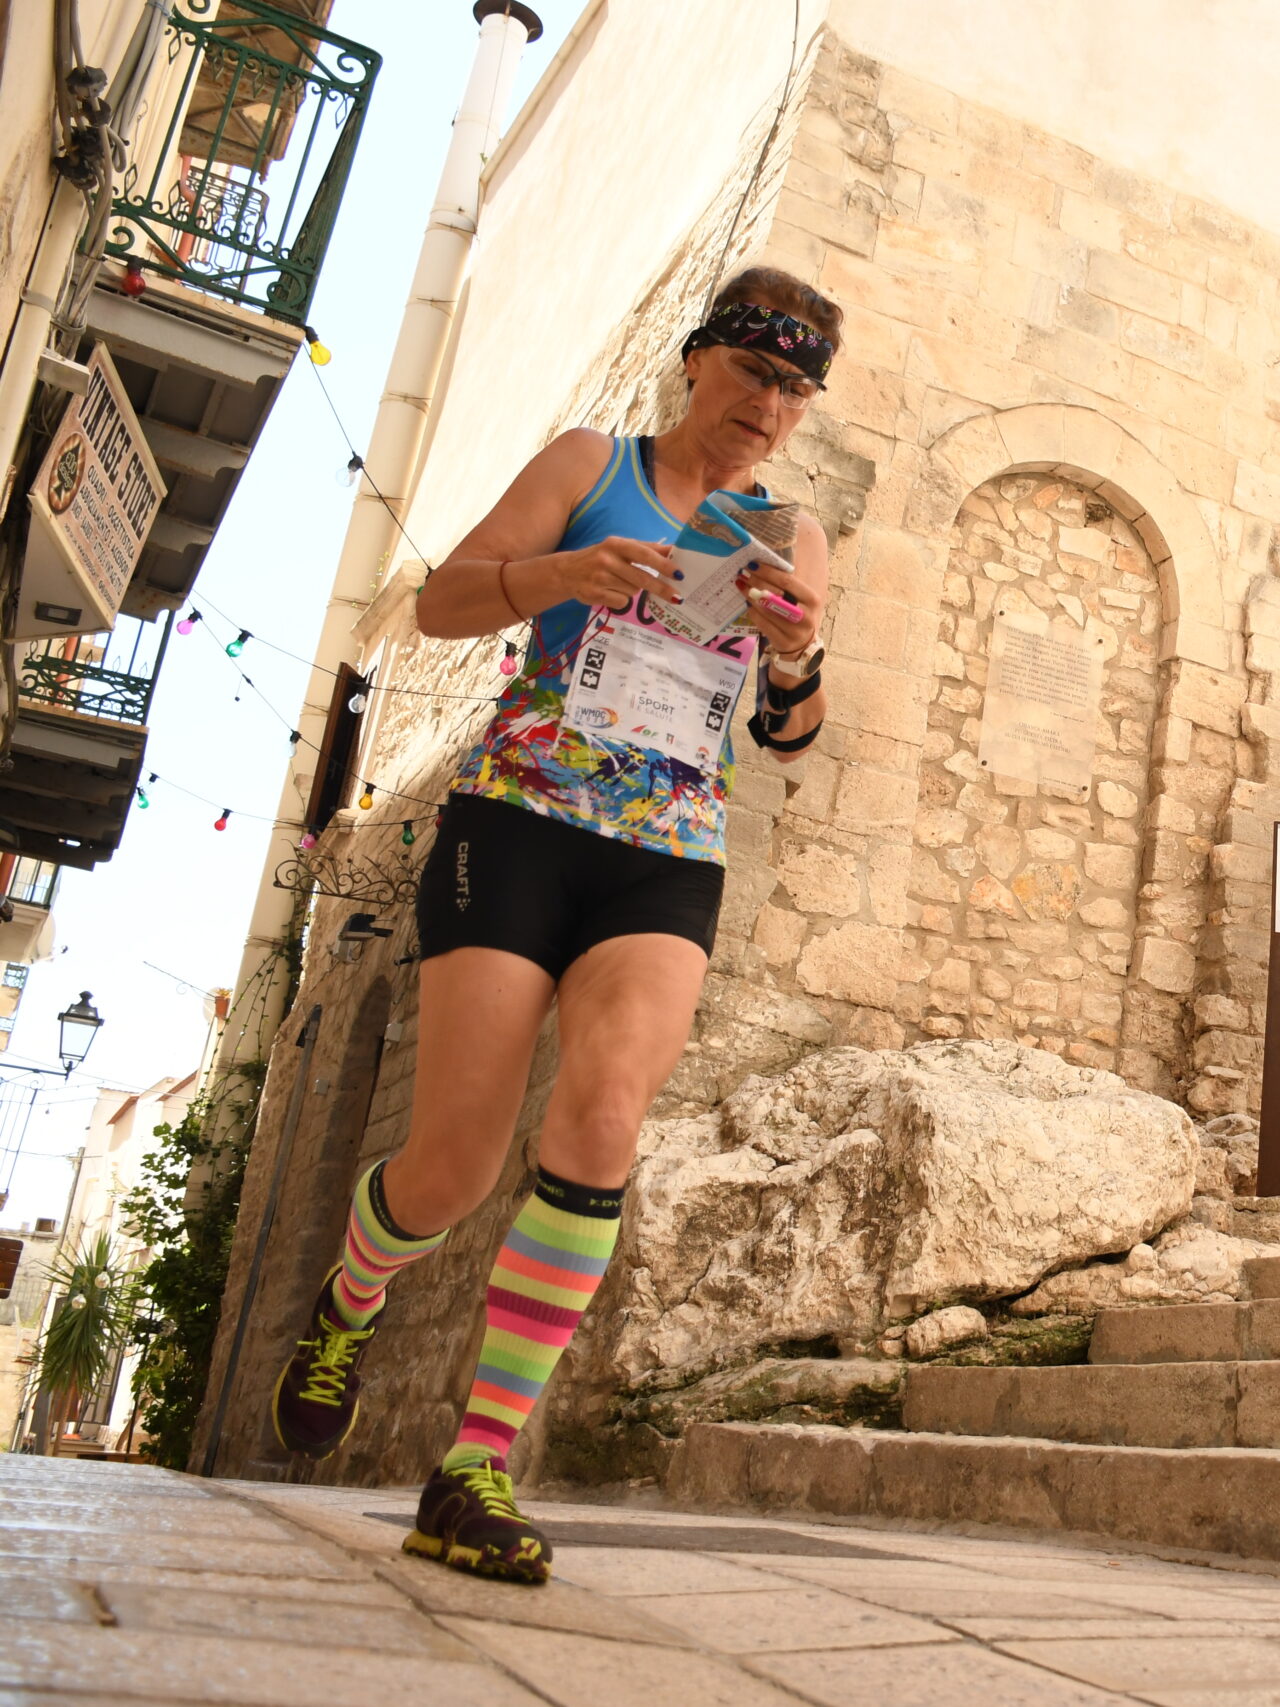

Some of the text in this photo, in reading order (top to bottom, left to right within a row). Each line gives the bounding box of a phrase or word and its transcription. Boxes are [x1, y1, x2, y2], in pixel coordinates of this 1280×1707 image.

[78, 366, 131, 485] VINTAGE
[117, 452, 156, 541] STORE
[88, 465, 107, 504] QUADRI
[639, 696, 675, 714] SPORT
[457, 841, 469, 895] CRAFT
